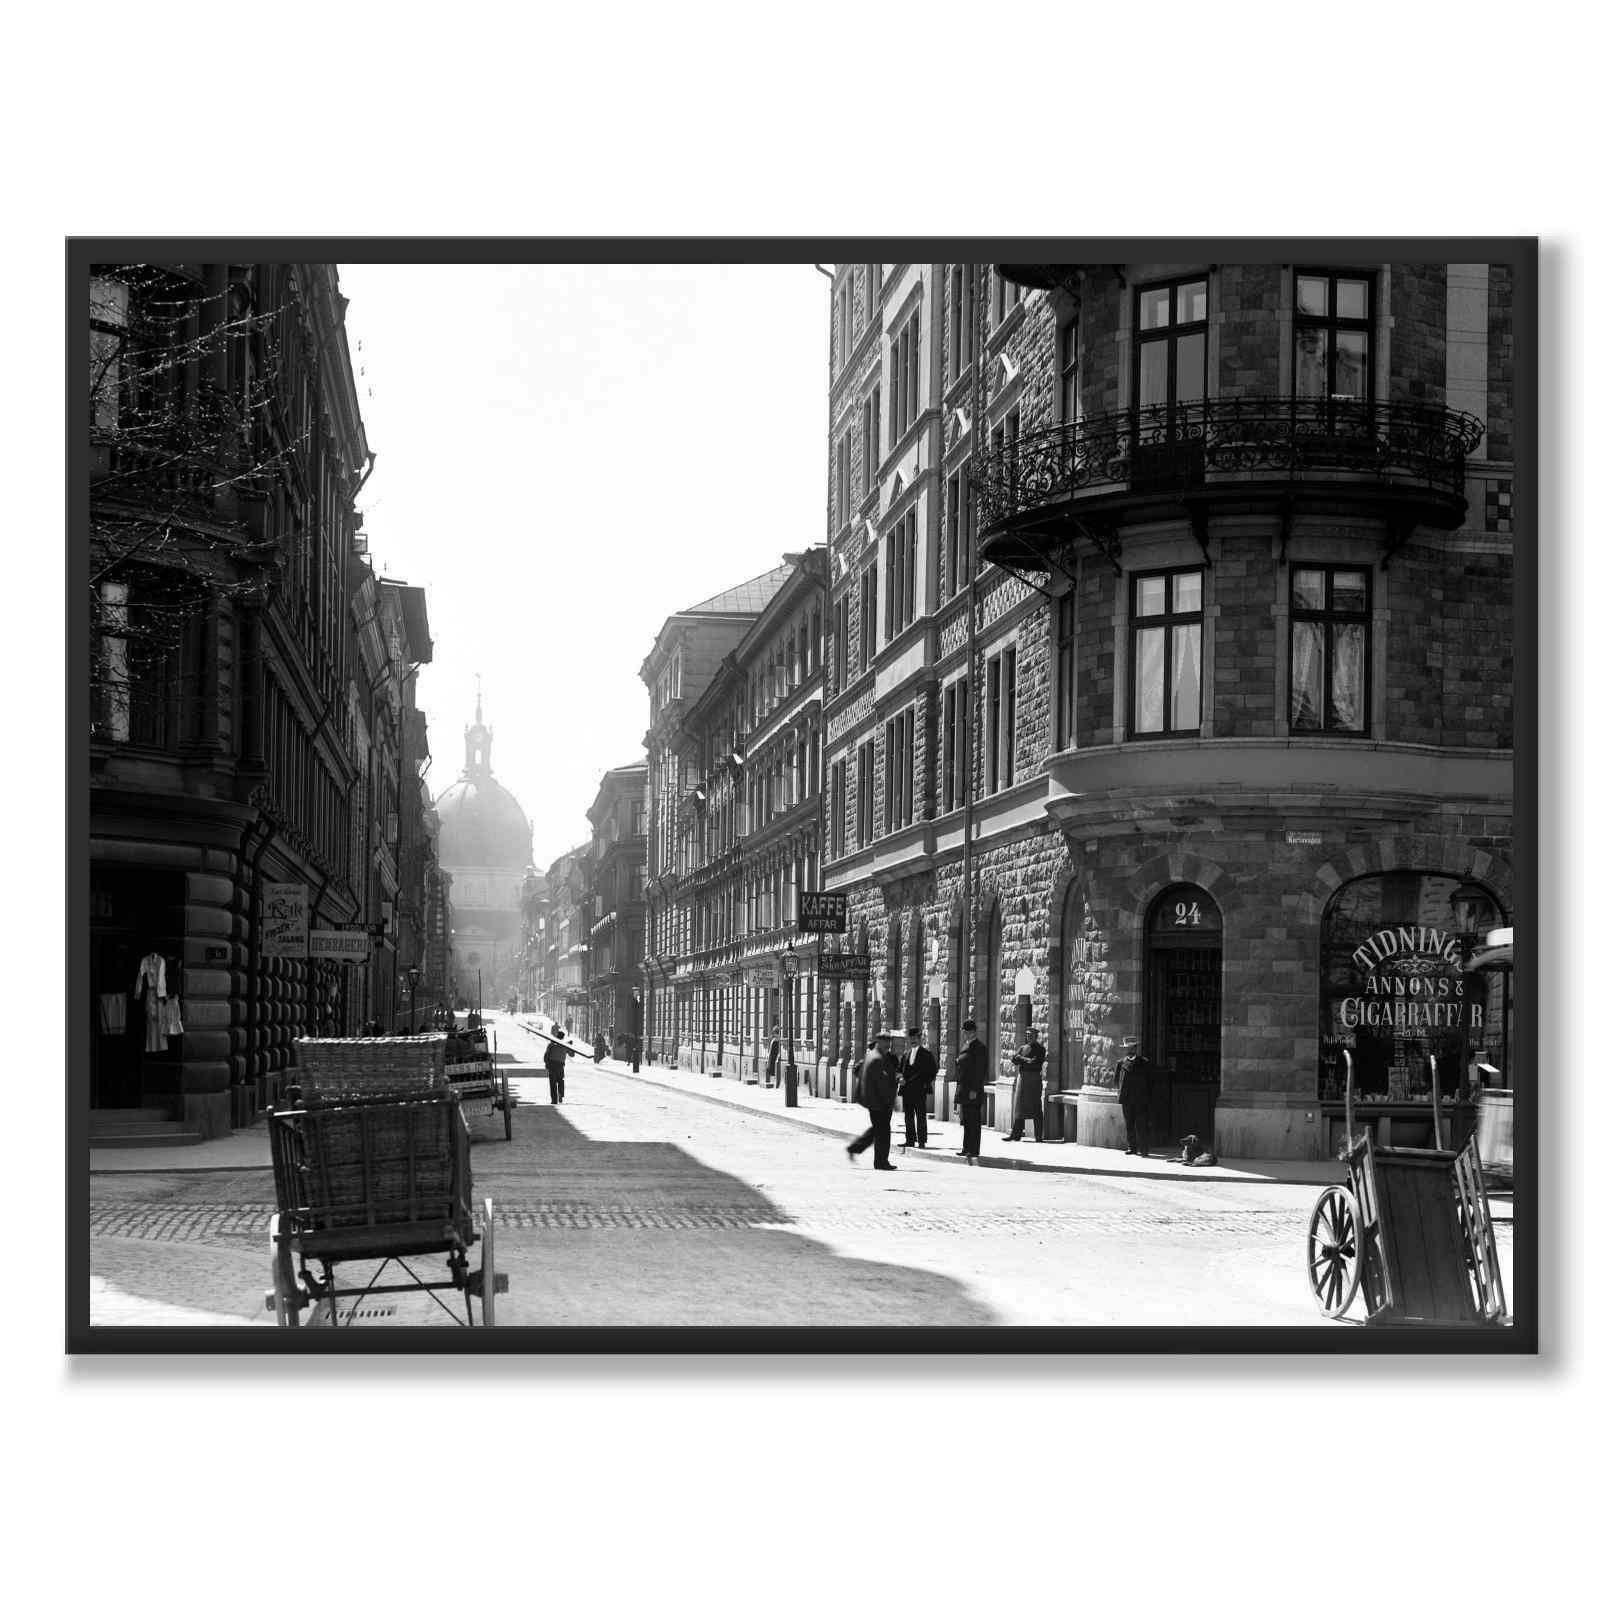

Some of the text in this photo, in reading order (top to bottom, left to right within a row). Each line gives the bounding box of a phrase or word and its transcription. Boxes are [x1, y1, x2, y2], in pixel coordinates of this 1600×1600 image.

[802, 895, 845, 916] KAFFE
[1175, 902, 1201, 925] 24
[1365, 976, 1450, 996] ANNONS
